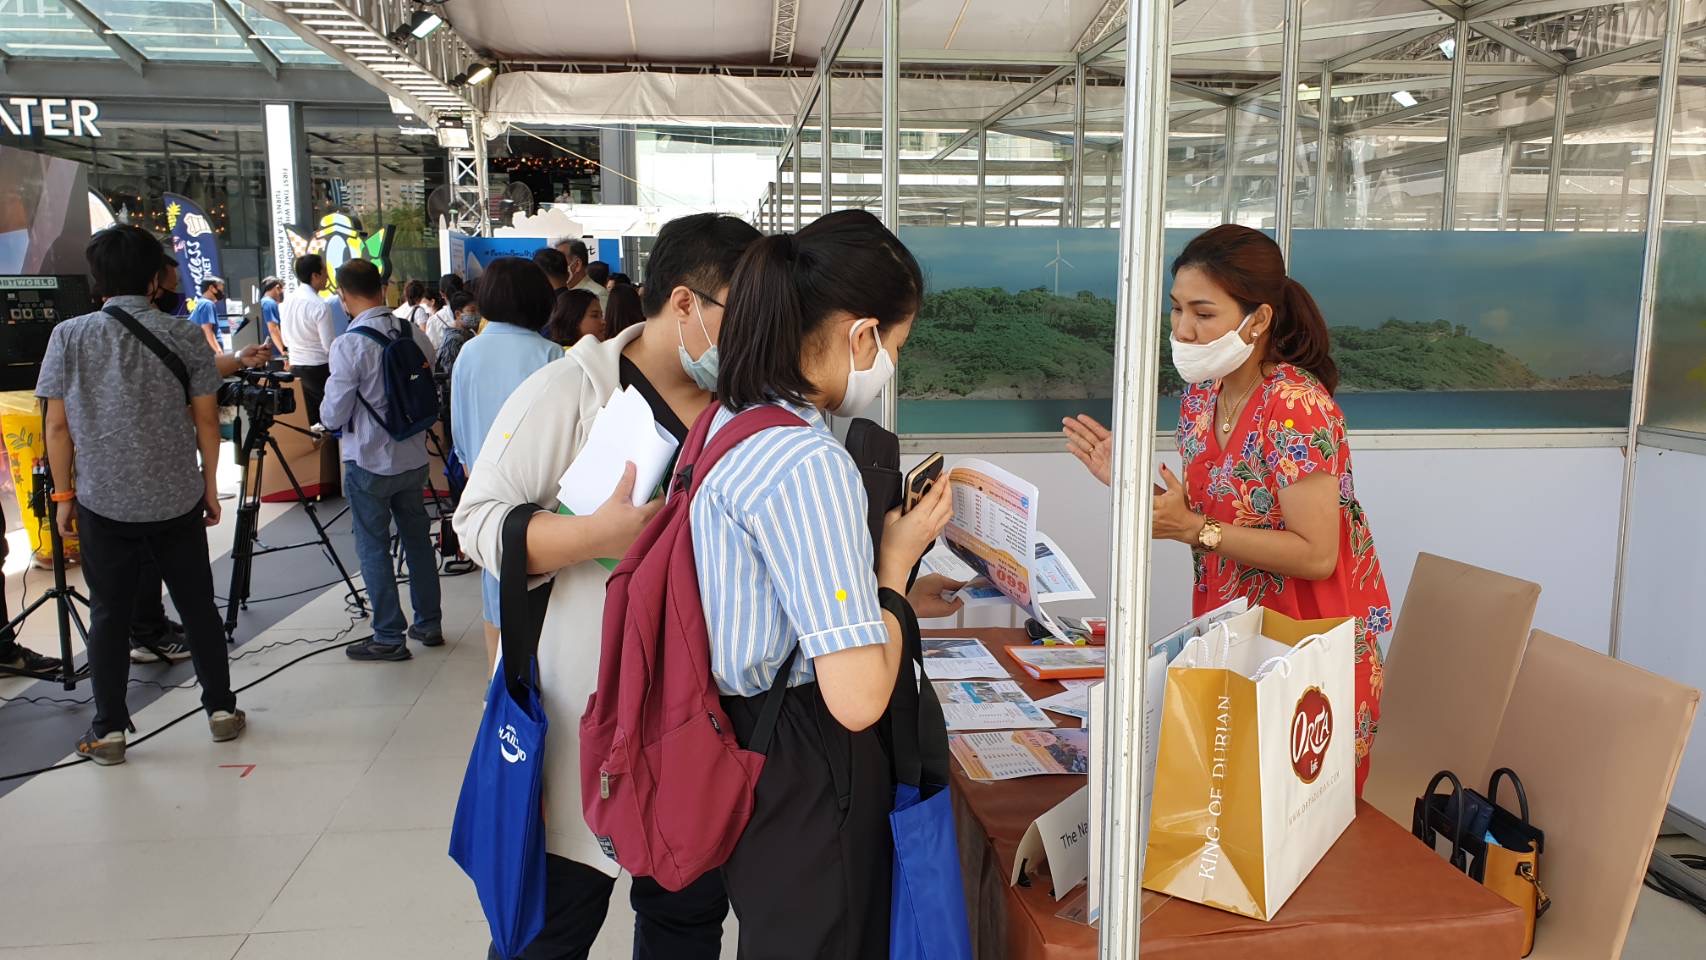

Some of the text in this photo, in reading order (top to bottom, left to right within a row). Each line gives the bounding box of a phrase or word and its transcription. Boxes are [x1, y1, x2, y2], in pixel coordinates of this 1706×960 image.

[1292, 705, 1330, 764] ORTA
[1199, 695, 1232, 880] KING OF DURIAN
[1060, 831, 1078, 849] The
